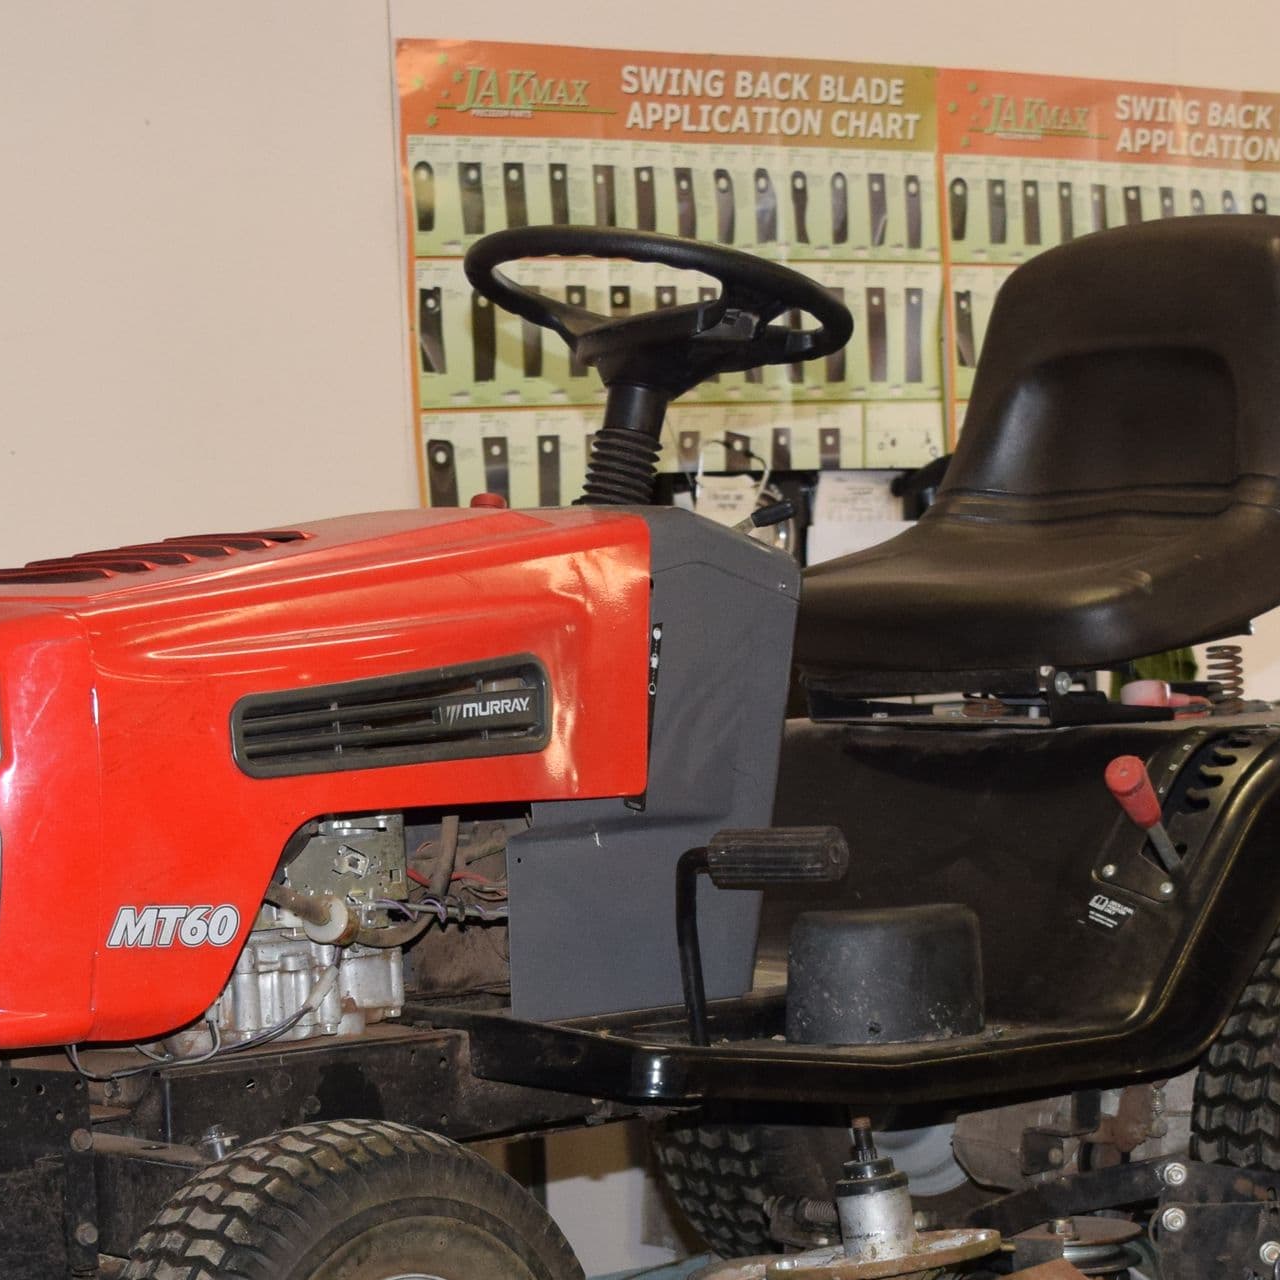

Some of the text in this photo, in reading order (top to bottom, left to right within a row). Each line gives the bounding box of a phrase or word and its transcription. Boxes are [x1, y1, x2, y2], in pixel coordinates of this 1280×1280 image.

[621, 65, 905, 106] SWING BACK BLADE
[625, 100, 920, 140] APPLICATION CHART
[1115, 94, 1201, 125] SWING
[1207, 101, 1272, 129] BACK
[463, 697, 529, 718] MURRAY
[106, 904, 240, 948] MT60
